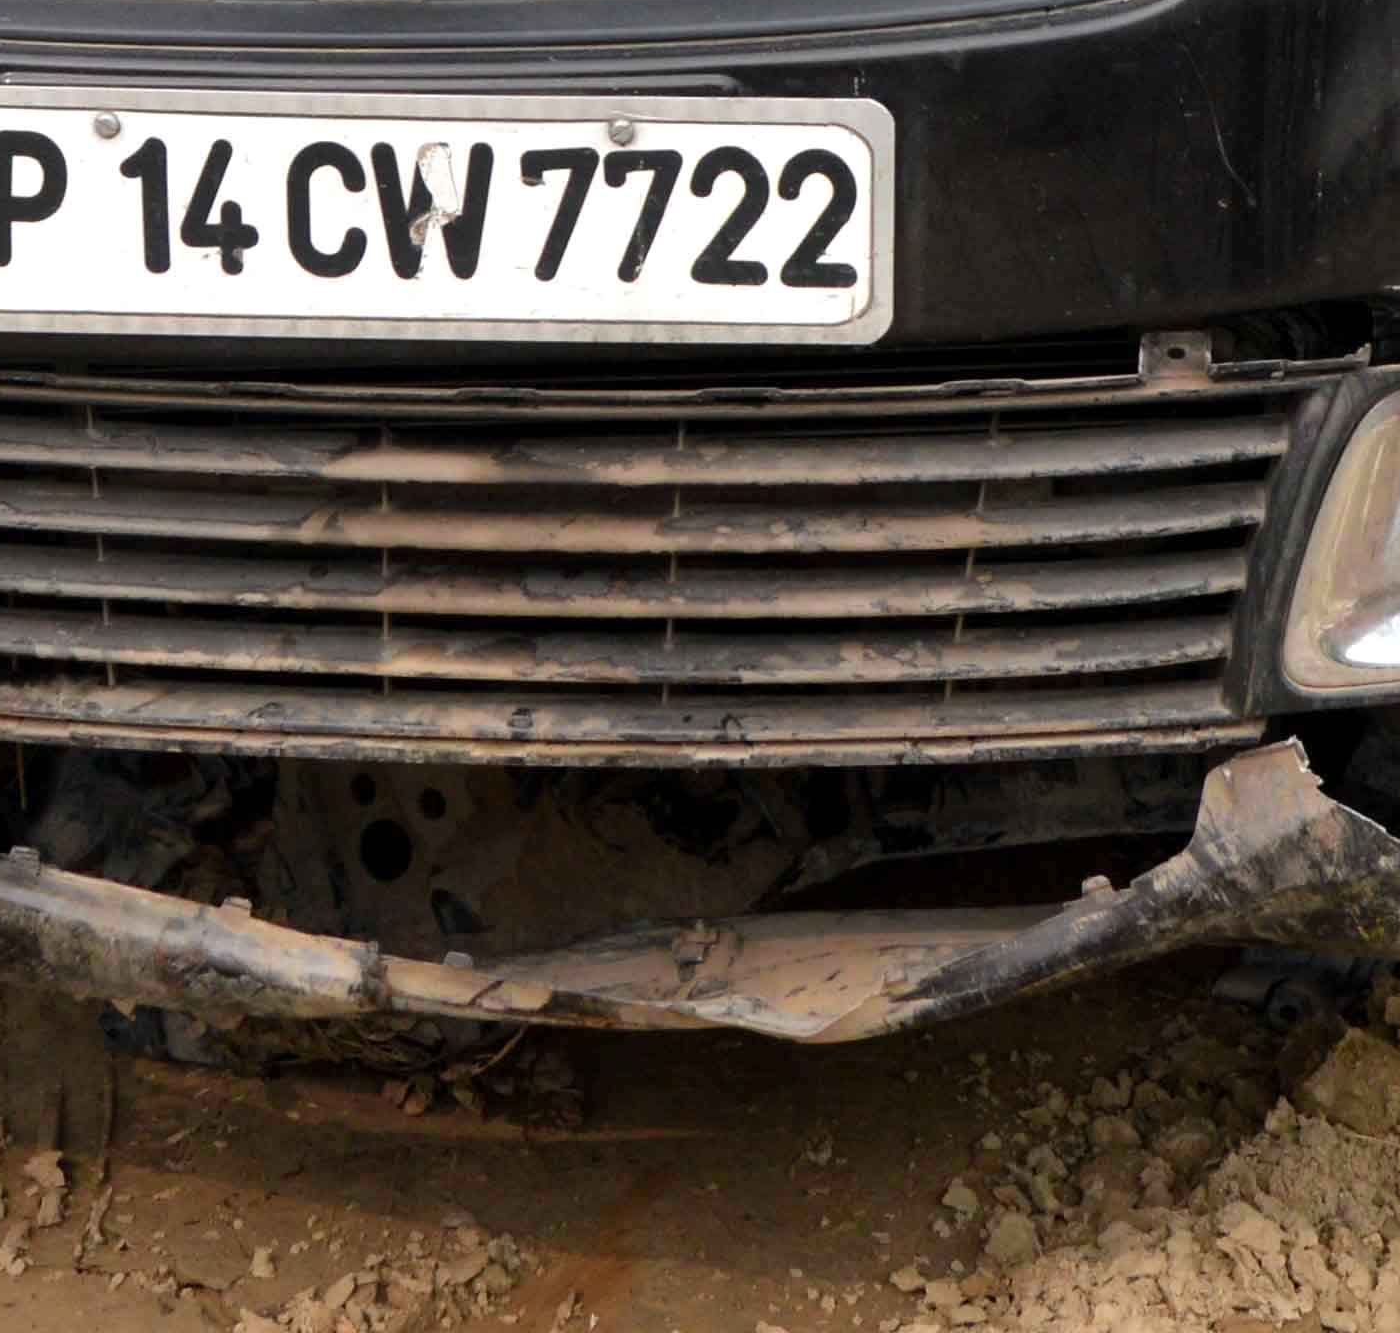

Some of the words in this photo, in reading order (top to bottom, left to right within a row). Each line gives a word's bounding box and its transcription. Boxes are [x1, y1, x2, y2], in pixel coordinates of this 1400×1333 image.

[119, 136, 259, 275] 14
[286, 141, 494, 281] CW
[518, 147, 859, 289] 7722
